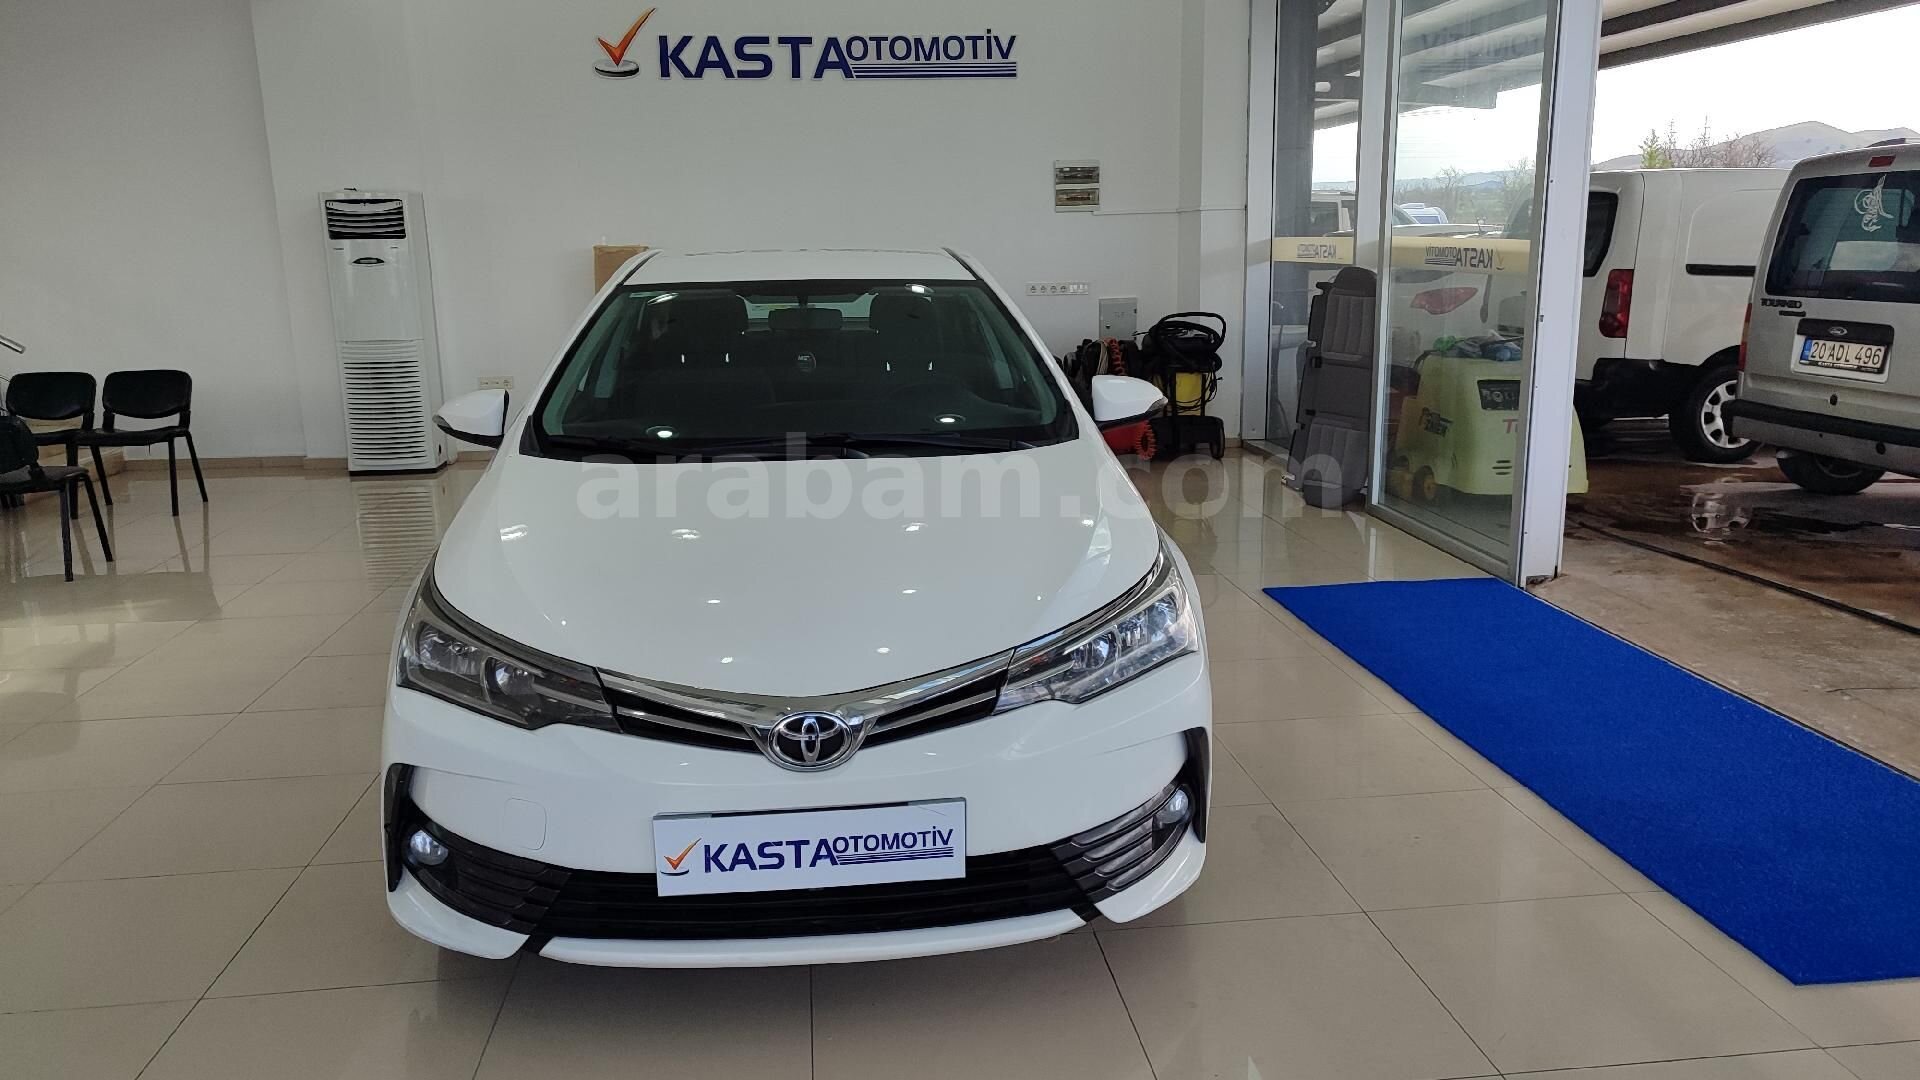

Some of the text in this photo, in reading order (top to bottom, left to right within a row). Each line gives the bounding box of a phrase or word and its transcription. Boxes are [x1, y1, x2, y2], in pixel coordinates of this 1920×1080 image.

[658, 29, 1017, 79] KASTA OTOMOTİV
[1810, 341, 1882, 366] 20 ADL 496
[704, 825, 954, 874] KASTA OTOMOTİV
